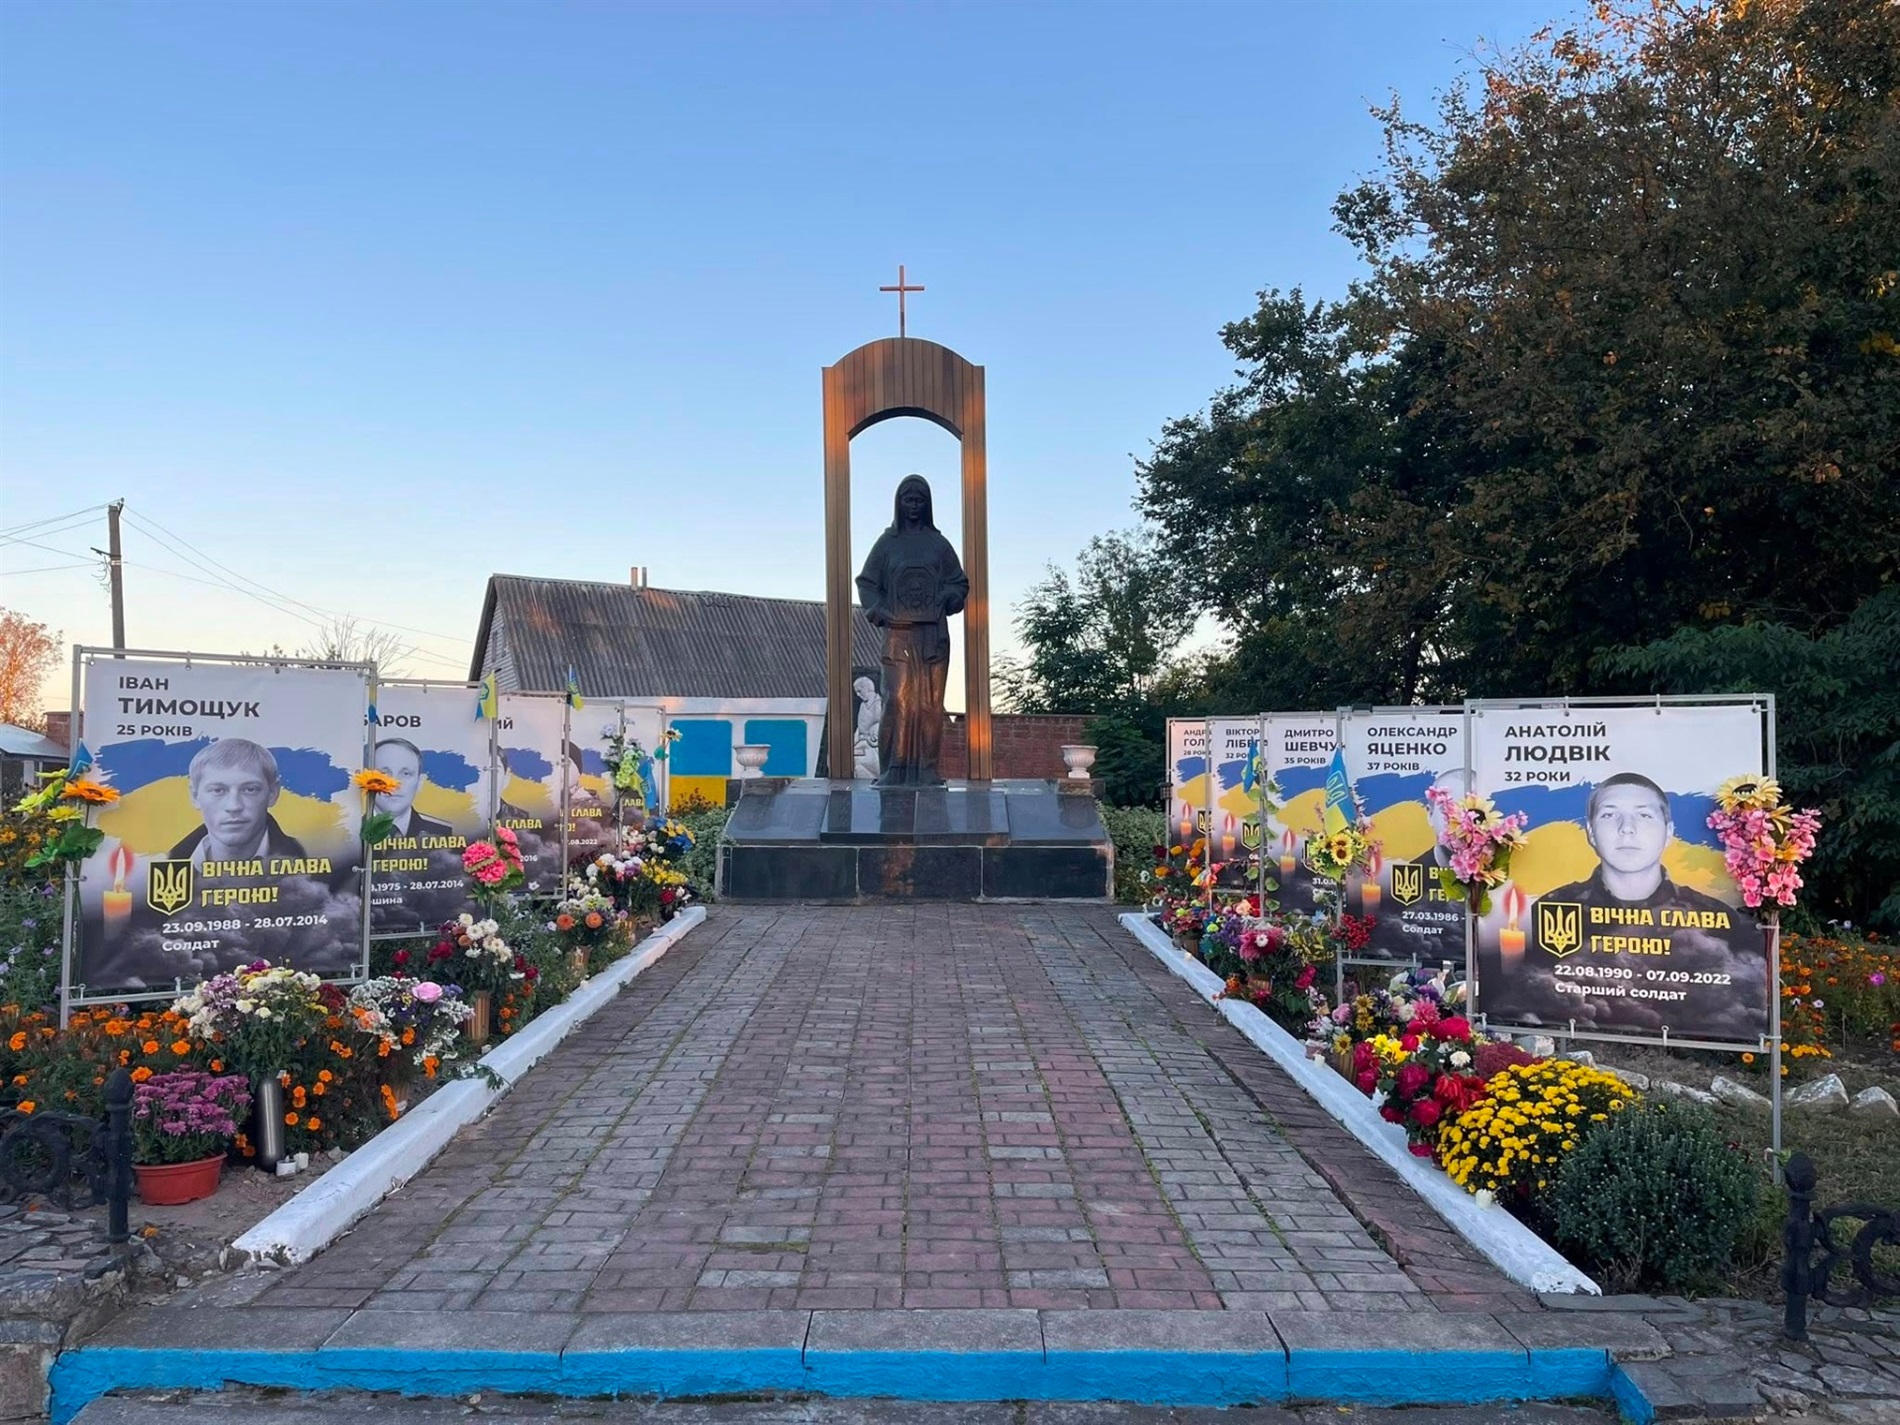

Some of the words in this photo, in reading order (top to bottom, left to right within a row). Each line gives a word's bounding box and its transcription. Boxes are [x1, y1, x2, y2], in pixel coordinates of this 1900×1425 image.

[119, 676, 169, 691] ІВАН
[118, 697, 260, 719] ТИМОЩУК
[116, 724, 135, 736] 25
[141, 725, 193, 737] РОКІВ
[1225, 728, 1260, 736] ВІКТОР
[1284, 729, 1334, 738] ДМИТРО
[1367, 727, 1457, 738] ОЛЕКСАНДР
[1504, 721, 1606, 738] АНАТОЛІЙ
[1368, 742, 1447, 757] ЯЦЕНКО
[1504, 745, 1611, 764] ЛЮДВІК
[1367, 762, 1380, 771] 37
[1383, 762, 1420, 771] РОКІВ
[1504, 771, 1522, 782] 32
[1526, 771, 1571, 782] РОКИ
[571, 808, 603, 817] СЛАВА
[505, 819, 543, 829] СЛАВА
[421, 836, 467, 849] СЛАВА
[202, 860, 264, 878] ВІЧНА
[270, 858, 332, 875] СЛАВА
[372, 858, 429, 874] ГЕРОЮ!
[409, 880, 464, 890] 28.07.2014
[201, 886, 279, 908] ГЕРОЮ!
[371, 897, 403, 905] шина
[1402, 911, 1459, 921] 27.03.1986
[1590, 907, 1654, 926] ВІЧНА
[1660, 909, 1731, 929] СЛАВА
[162, 919, 241, 934] 23.09.1988
[254, 915, 328, 928] 28.07.2014
[1402, 924, 1444, 935] Солдат
[162, 940, 220, 952] Солдат
[1590, 935, 1672, 955] ГЕРОЮ!
[1554, 964, 1633, 980] 22.08.1990
[1646, 970, 1732, 986] 07.09.2022
[1554, 982, 1626, 997] Старший
[1629, 989, 1687, 1001] солдат
